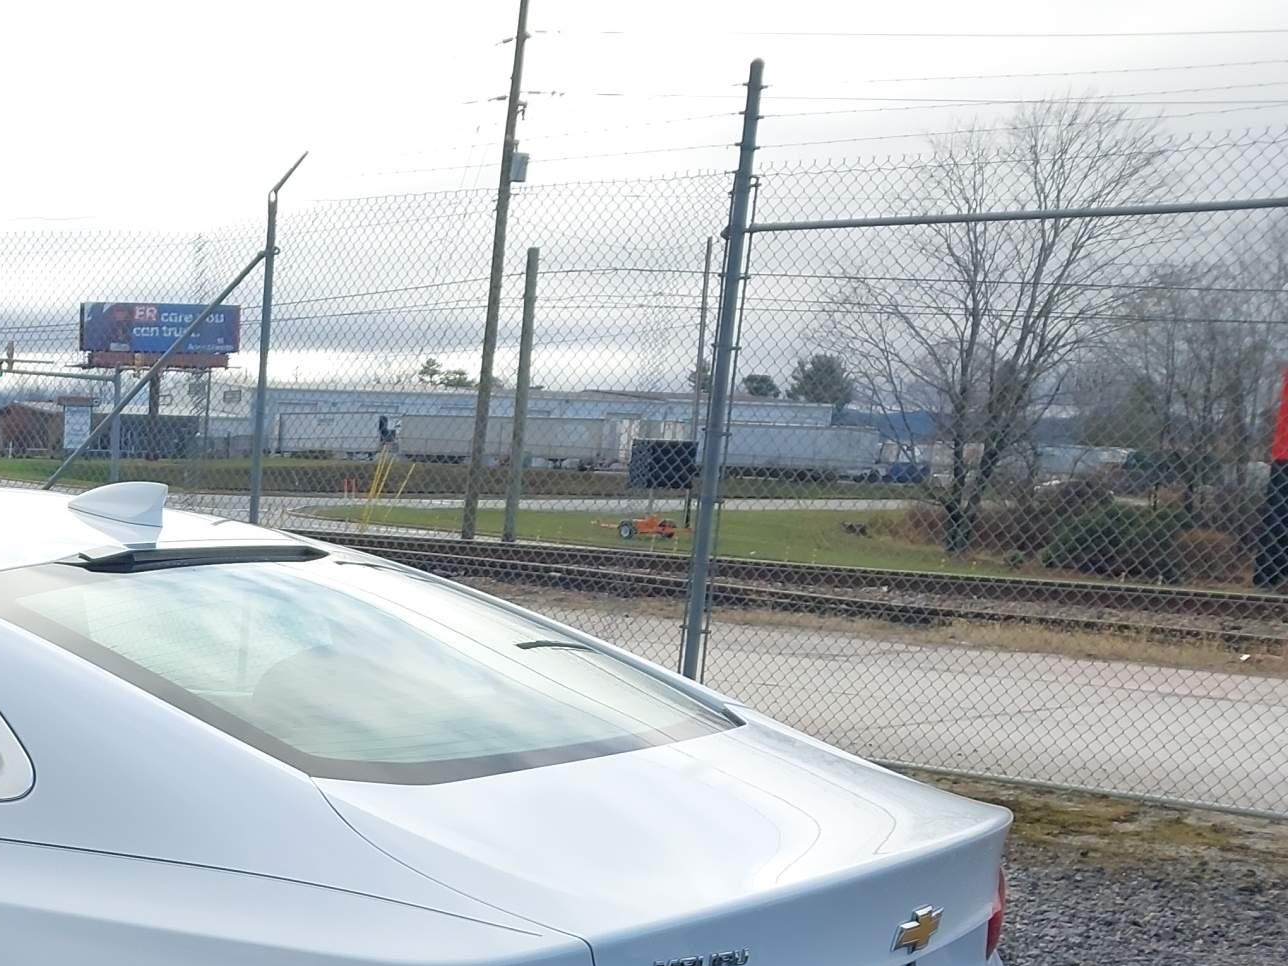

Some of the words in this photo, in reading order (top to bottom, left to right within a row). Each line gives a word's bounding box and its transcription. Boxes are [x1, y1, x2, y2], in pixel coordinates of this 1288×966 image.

[134, 305, 158, 321] ER
[160, 312, 193, 323] care
[132, 326, 159, 337] can
